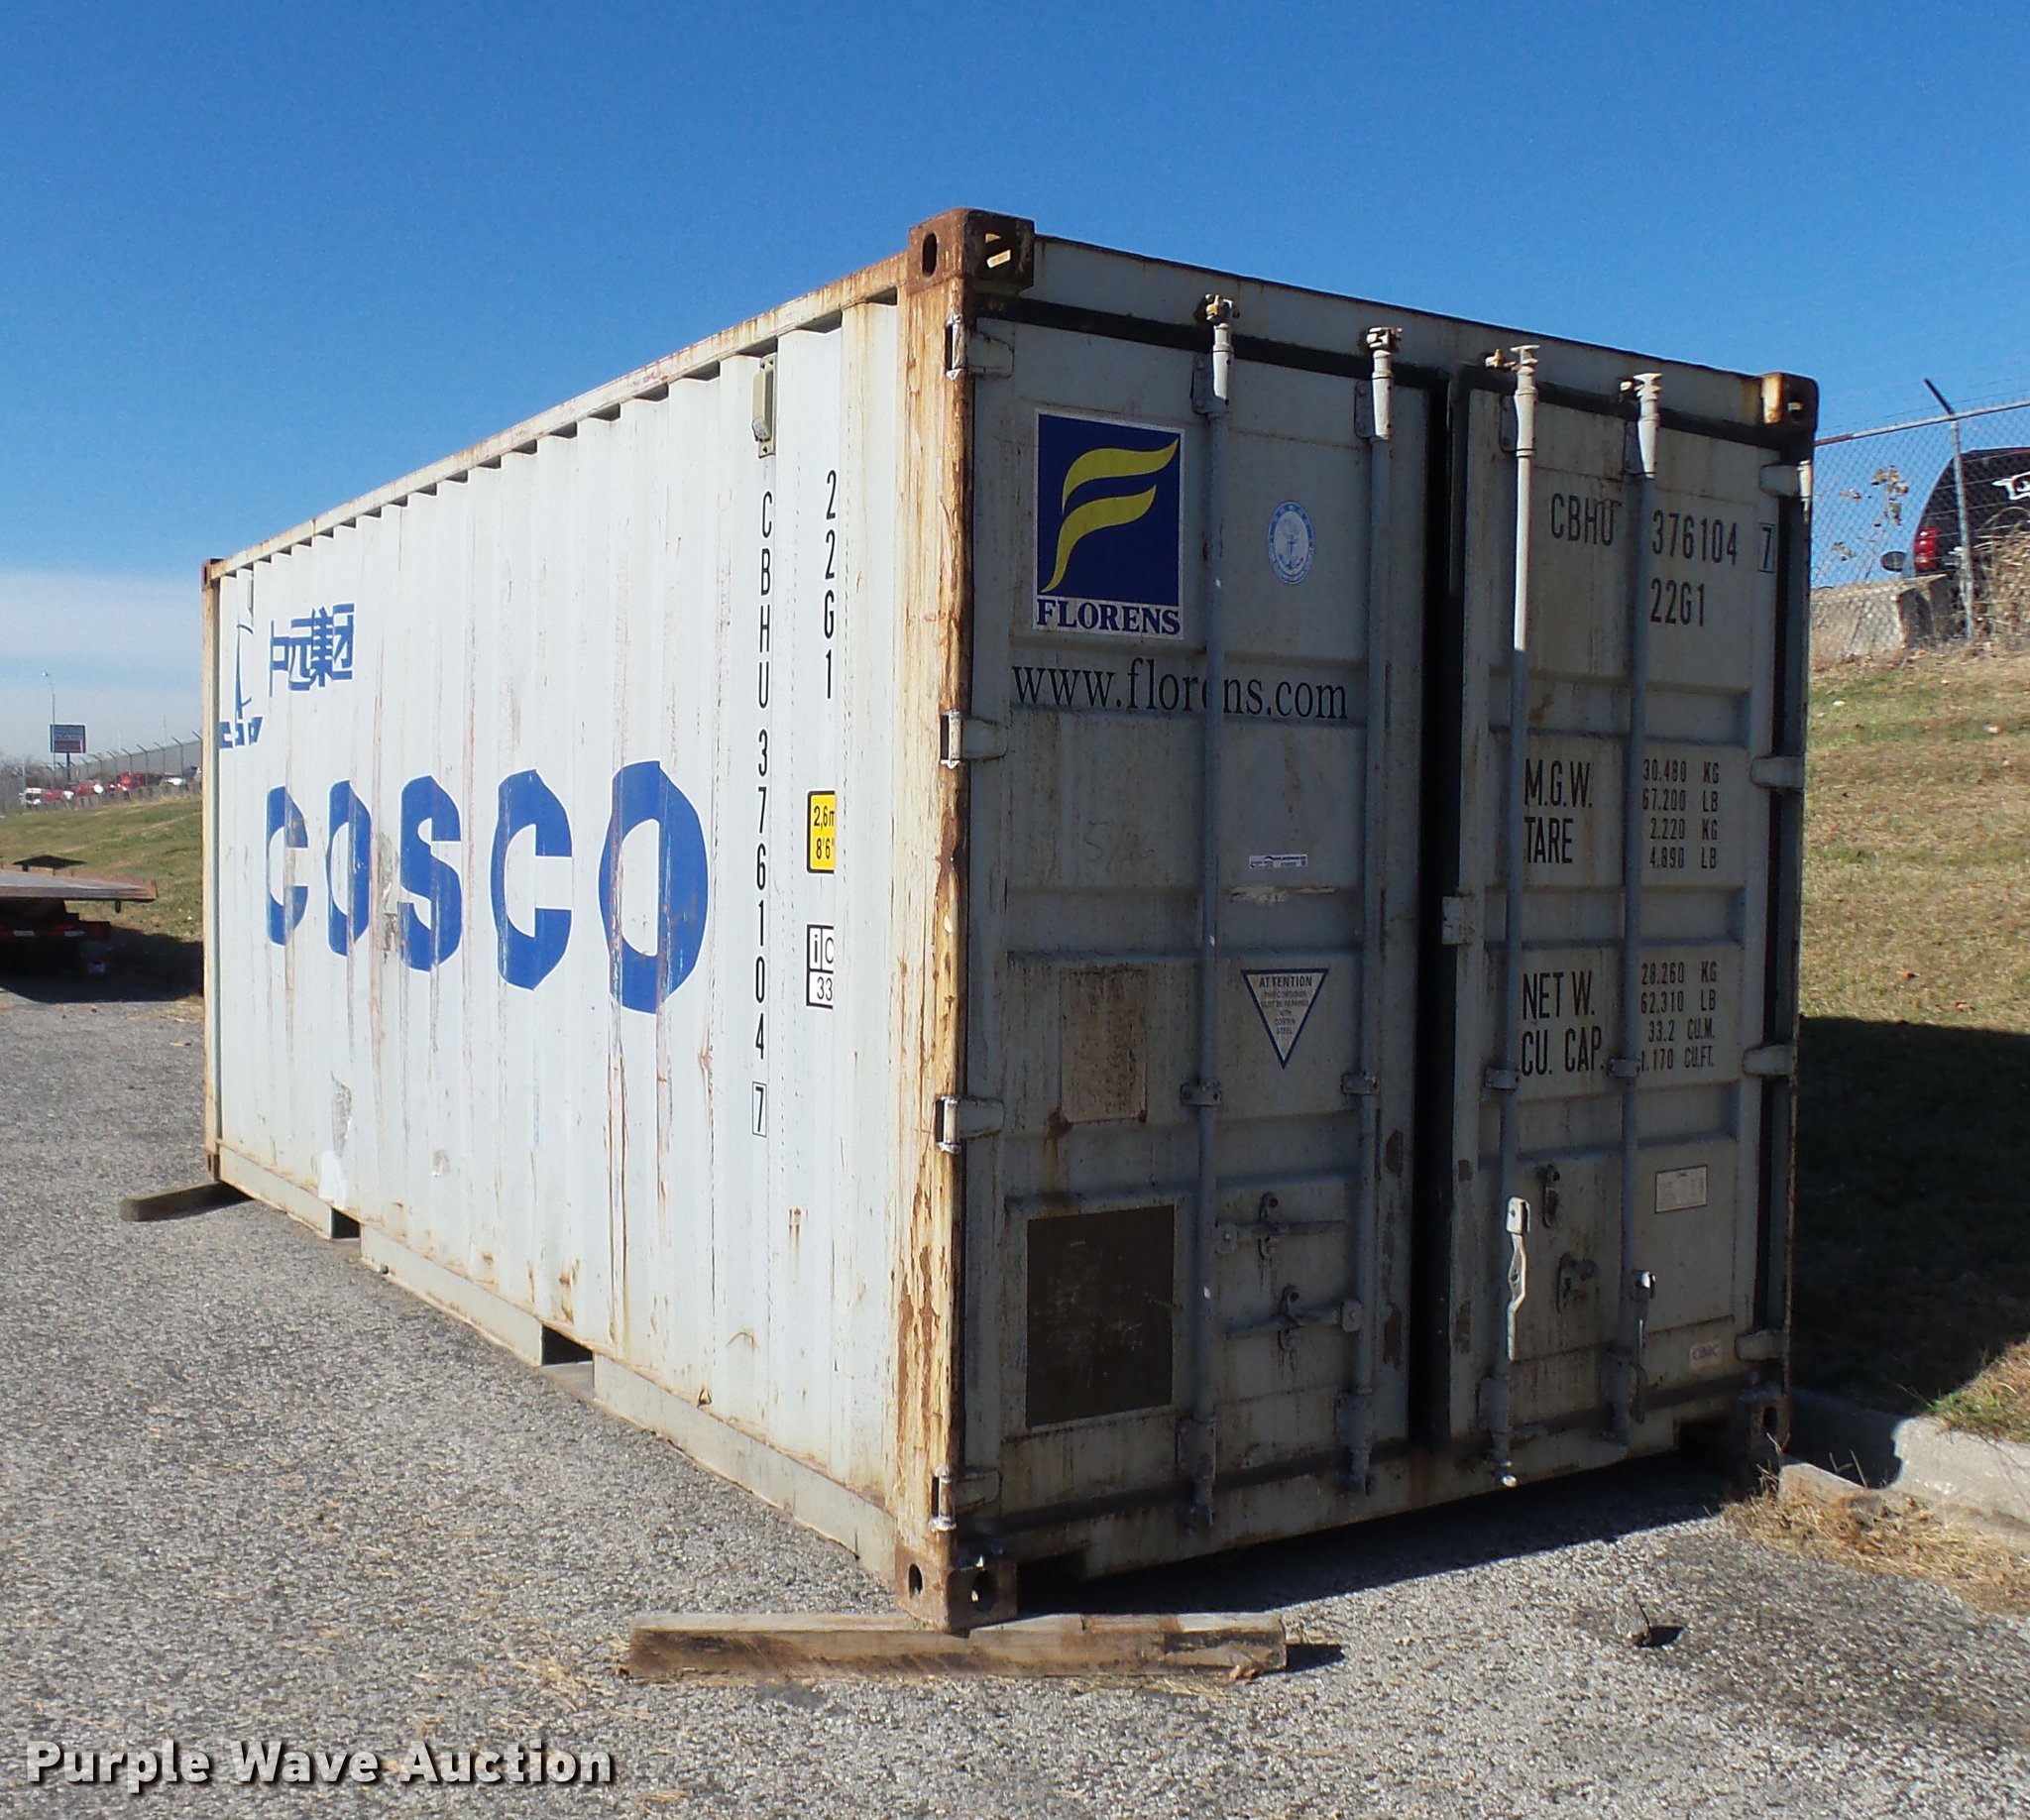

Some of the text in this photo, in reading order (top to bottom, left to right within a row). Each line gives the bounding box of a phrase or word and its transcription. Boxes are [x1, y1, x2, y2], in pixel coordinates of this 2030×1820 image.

[1549, 493, 1616, 546] CBHU
[1651, 509, 1739, 567] 376104
[758, 490, 773, 710] CBHU
[824, 469, 838, 700] 22G1
[1649, 577, 1705, 627] 22G1
[1036, 598, 1182, 636] FLORENS
[1703, 760, 1720, 784] KG
[1641, 787, 1719, 813] 67.200 LB
[1523, 816, 1719, 864] TARE 2.220 KG
[1648, 846, 1718, 869] 4.890 LB
[266, 759, 710, 1015] COSCO
[754, 728, 769, 1061] 376104
[817, 975, 834, 1001] 33
[1259, 974, 1313, 988] ATTENTION
[1522, 960, 1717, 1021] NET W. 28.260 KG
[1700, 988, 1717, 1011] LB
[1521, 1028, 1553, 1078] CU.
[1564, 1025, 1605, 1073] CAP.
[1648, 1019, 1675, 1043] 33.2
